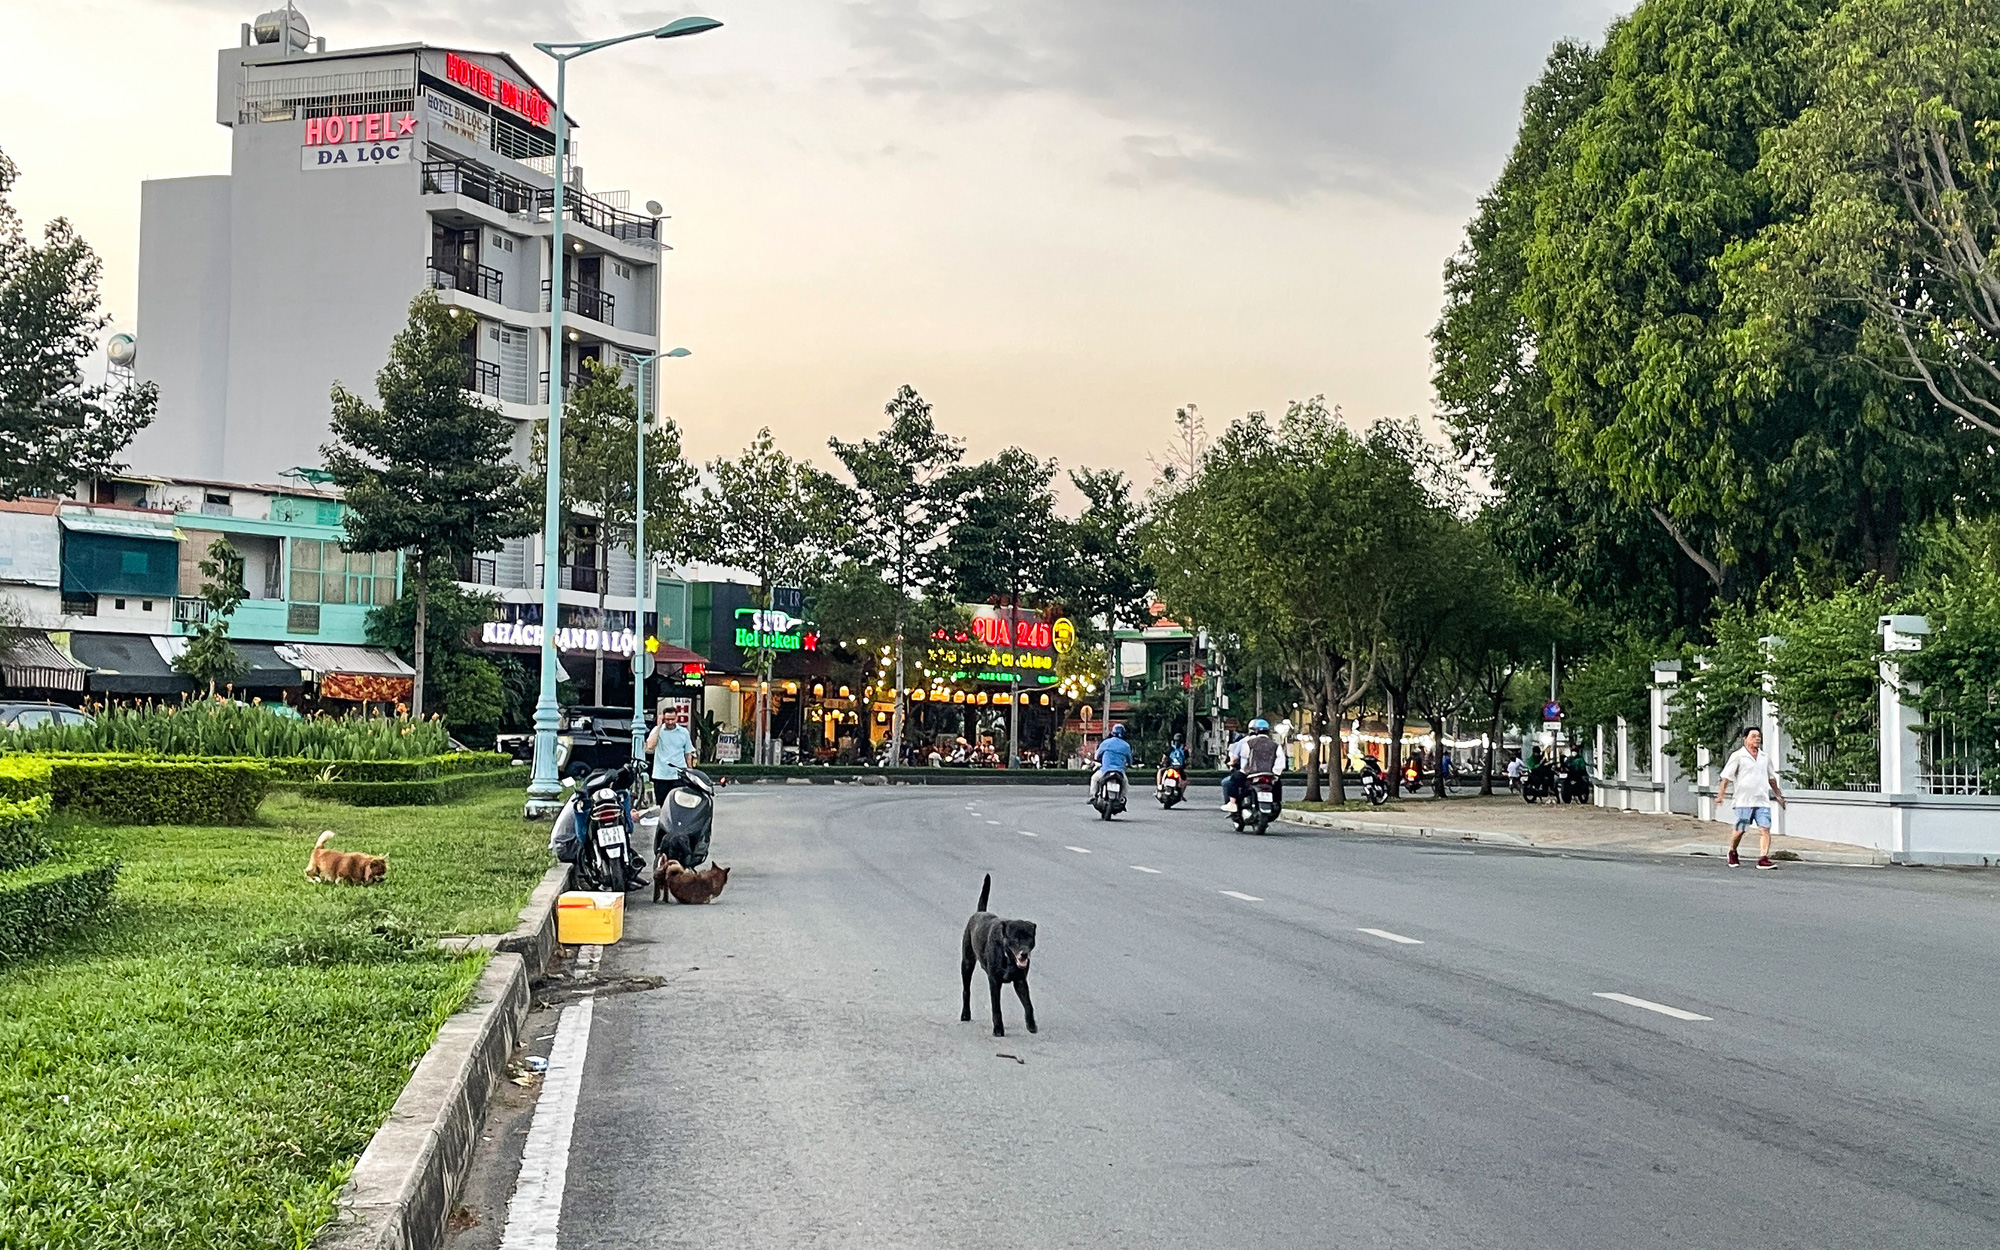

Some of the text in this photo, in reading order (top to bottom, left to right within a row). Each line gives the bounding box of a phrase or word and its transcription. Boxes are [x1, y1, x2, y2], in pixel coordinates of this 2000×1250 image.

[446, 52, 498, 100] HOTEL
[522, 88, 550, 127] LỘC
[427, 93, 453, 118] HOTEL
[305, 112, 398, 146] HOTEL
[317, 143, 400, 165] ĐA LỘC
[482, 619, 544, 647] KHÁCH
[1016, 620, 1052, 649] 245
